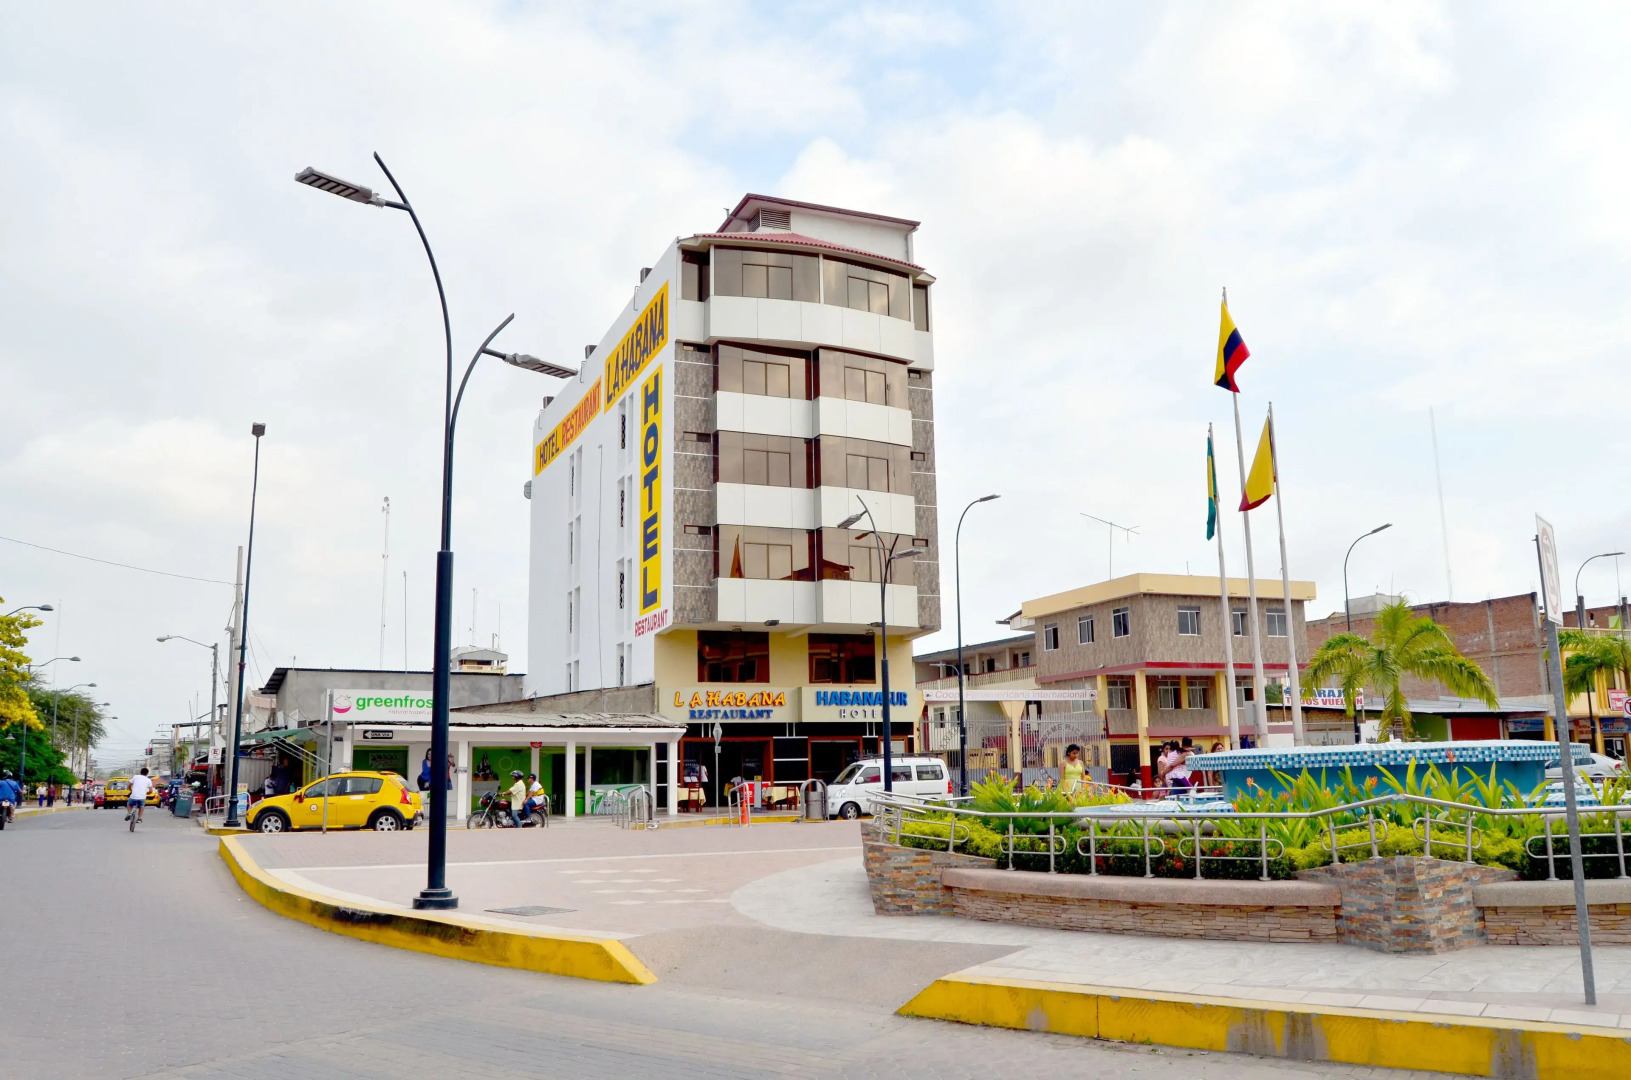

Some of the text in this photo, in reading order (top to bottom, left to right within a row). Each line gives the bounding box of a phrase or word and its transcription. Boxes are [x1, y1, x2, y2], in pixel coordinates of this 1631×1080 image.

[620, 292, 664, 382] HABANA
[539, 379, 602, 469] HOTEL RESTAURANT
[643, 372, 659, 610] HOTEL
[634, 608, 669, 638] RESTAURANT
[356, 695, 433, 711] greenfros
[688, 709, 773, 719] RESTAURANT
[706, 690, 786, 708] HABANA
